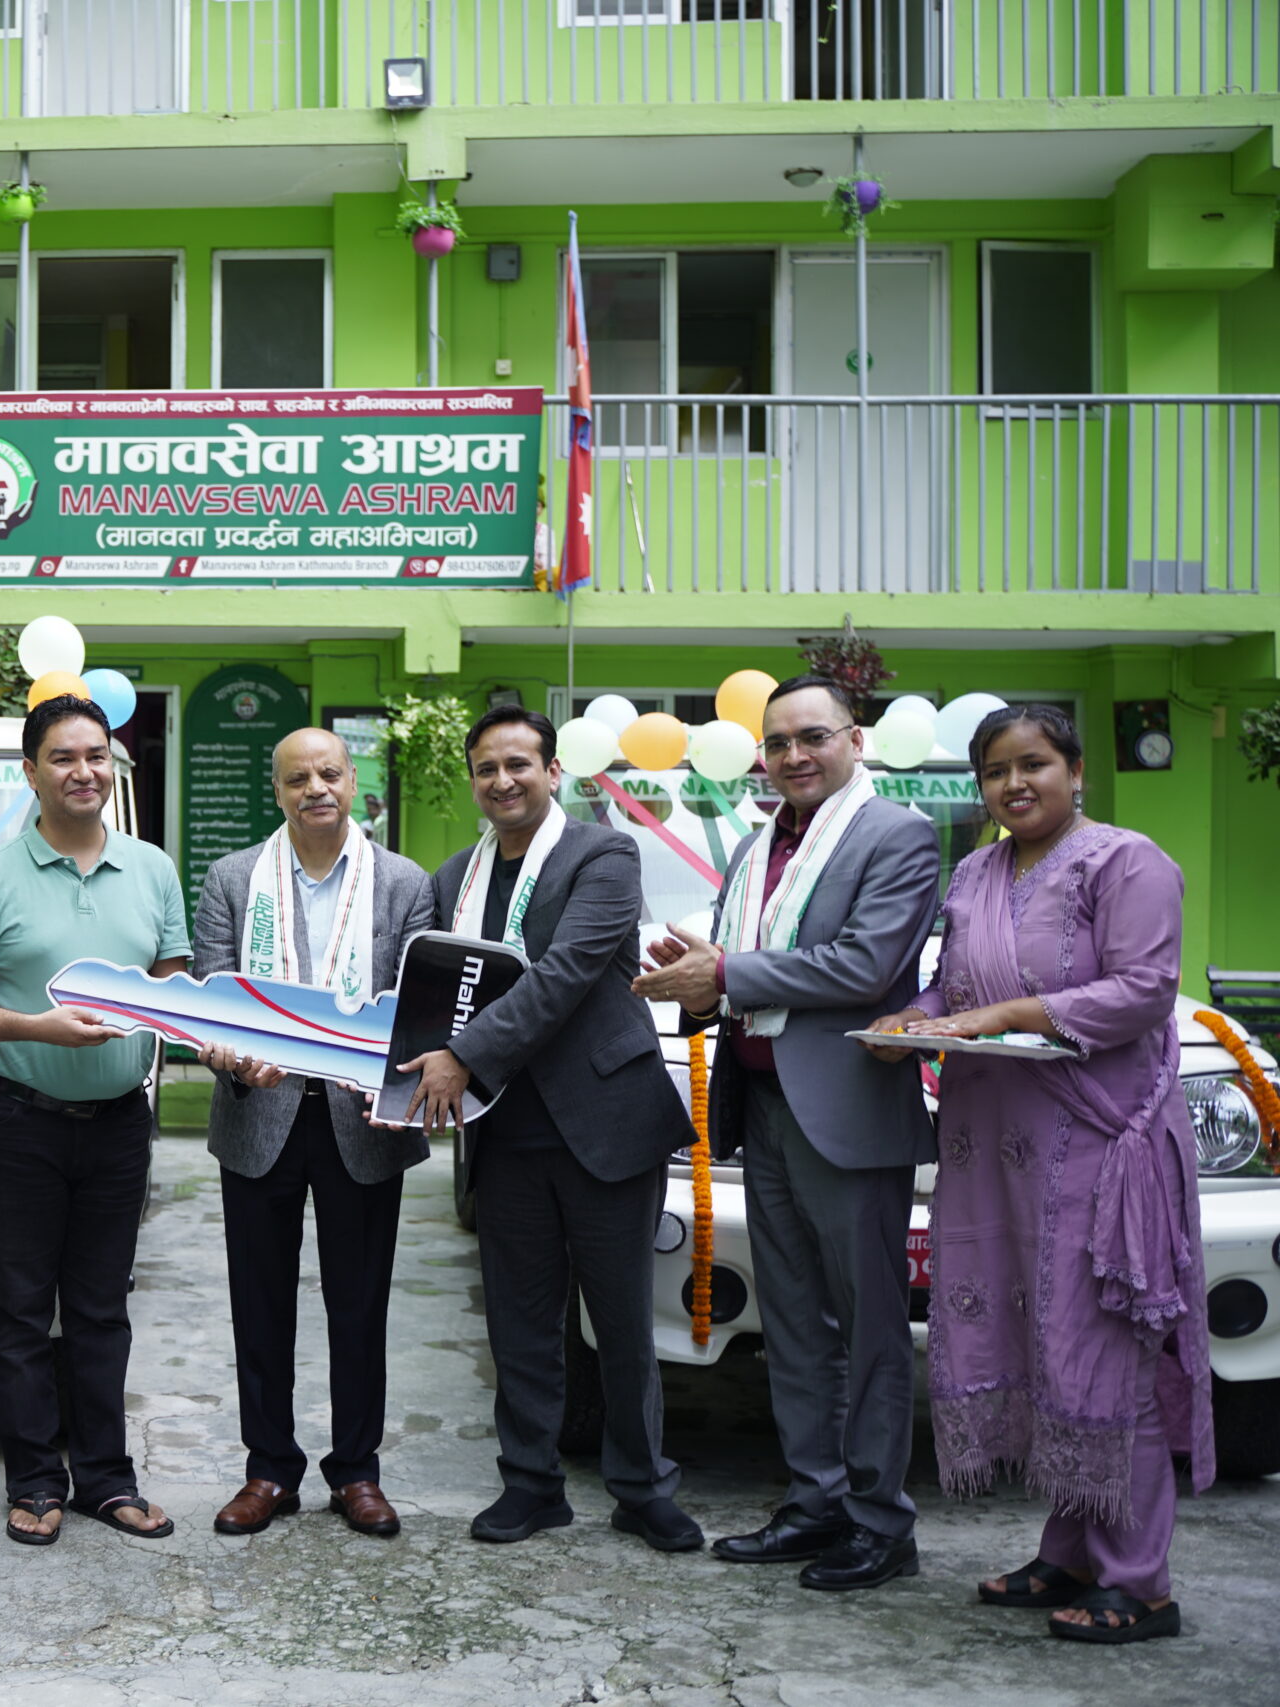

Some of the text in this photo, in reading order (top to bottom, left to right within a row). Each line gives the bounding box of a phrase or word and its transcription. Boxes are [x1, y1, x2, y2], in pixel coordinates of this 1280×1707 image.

[76, 401, 86, 413] र
[90, 398, 166, 414] मानवताप्रेमी
[329, 399, 339, 411] र
[54, 423, 526, 478] मानवसेवा आश्रम
[58, 482, 517, 516] MANAVSEWA ASHRAM
[96, 523, 206, 549] (मानवता
[309, 521, 478, 549] महाअभियान)
[65, 560, 159, 571] Manavsewa Ashram
[201, 560, 389, 571] Manavsewa Ashram Kathmandu Branch
[451, 955, 484, 1037] mahi
